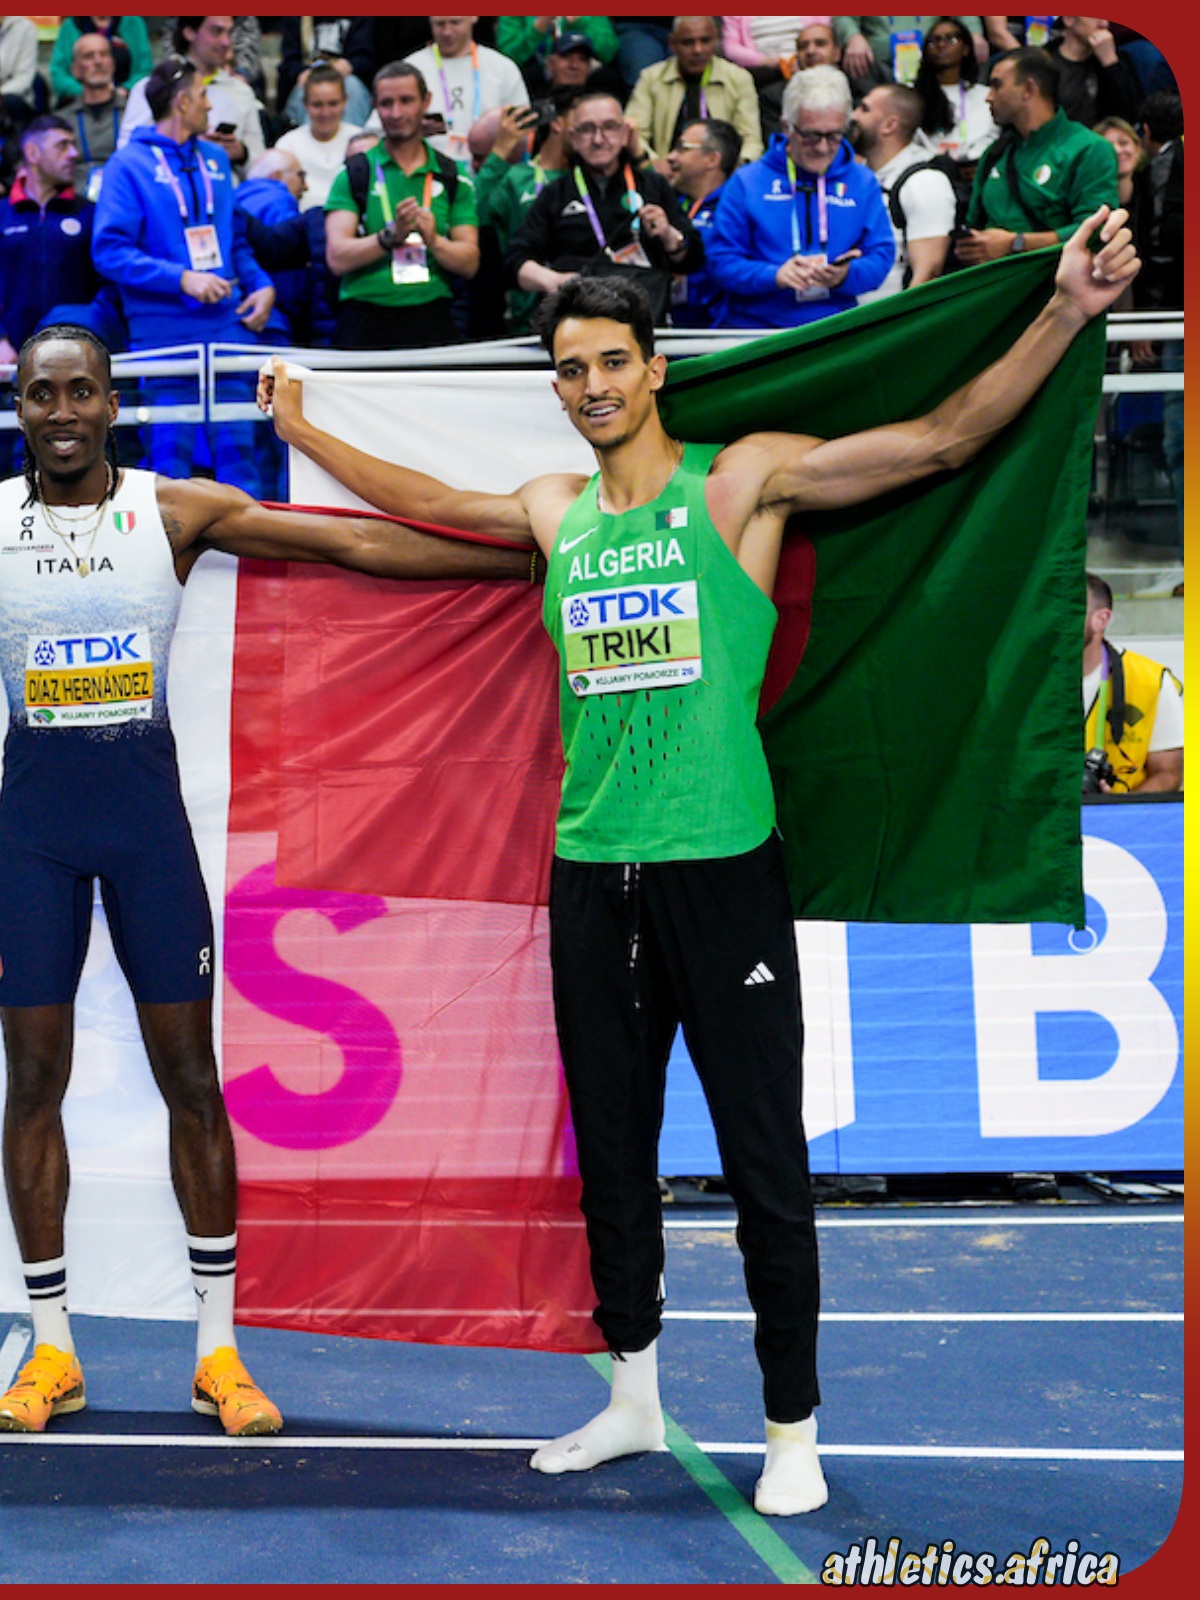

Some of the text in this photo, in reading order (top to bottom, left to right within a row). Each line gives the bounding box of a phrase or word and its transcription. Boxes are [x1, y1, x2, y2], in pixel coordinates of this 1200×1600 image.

[567, 538, 685, 584] ALGERIA
[588, 588, 685, 624] TDK
[56, 632, 141, 665] TDK
[582, 625, 671, 664] TRIKI
[29, 668, 150, 703] DÍAZ HERNÁNDEZ
[595, 666, 695, 686] KUJAWY POMORZE 26
[61, 711, 96, 721] KUJAWY
[98, 707, 138, 719] POMORZE
